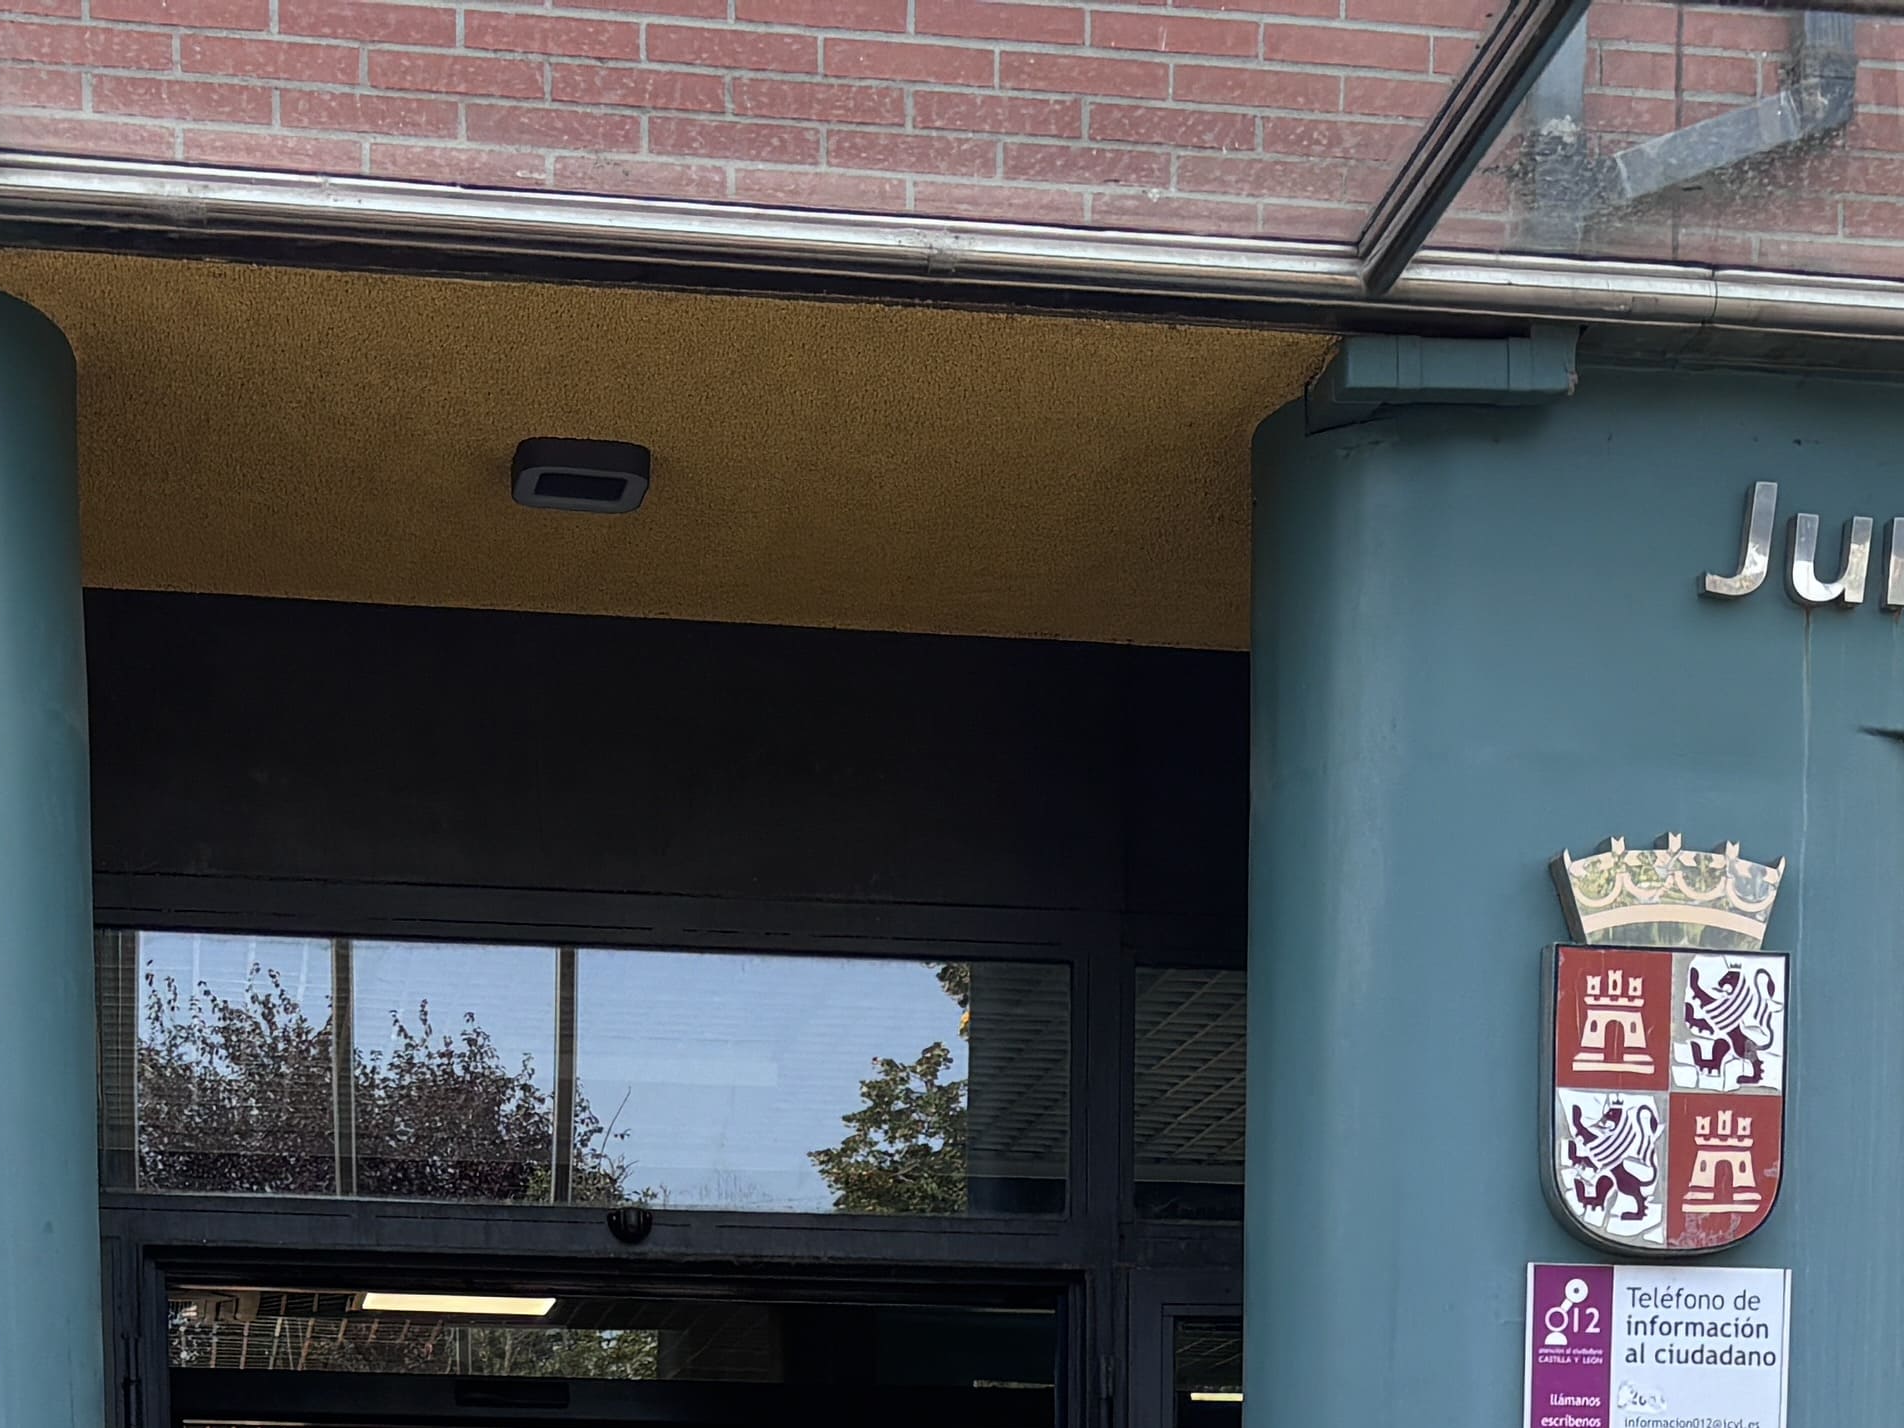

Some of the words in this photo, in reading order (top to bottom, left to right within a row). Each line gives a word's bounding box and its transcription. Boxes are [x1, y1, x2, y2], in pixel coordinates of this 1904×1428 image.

[1625, 1285, 1725, 1311] Teléfono
[1733, 1288, 1762, 1312] de
[1626, 1313, 1770, 1340] información
[1624, 1342, 1645, 1365] al
[1654, 1343, 1777, 1367] ciudadano
[1549, 1392, 1602, 1407] llámanos
[1540, 1413, 1602, 1428] escríbenos
